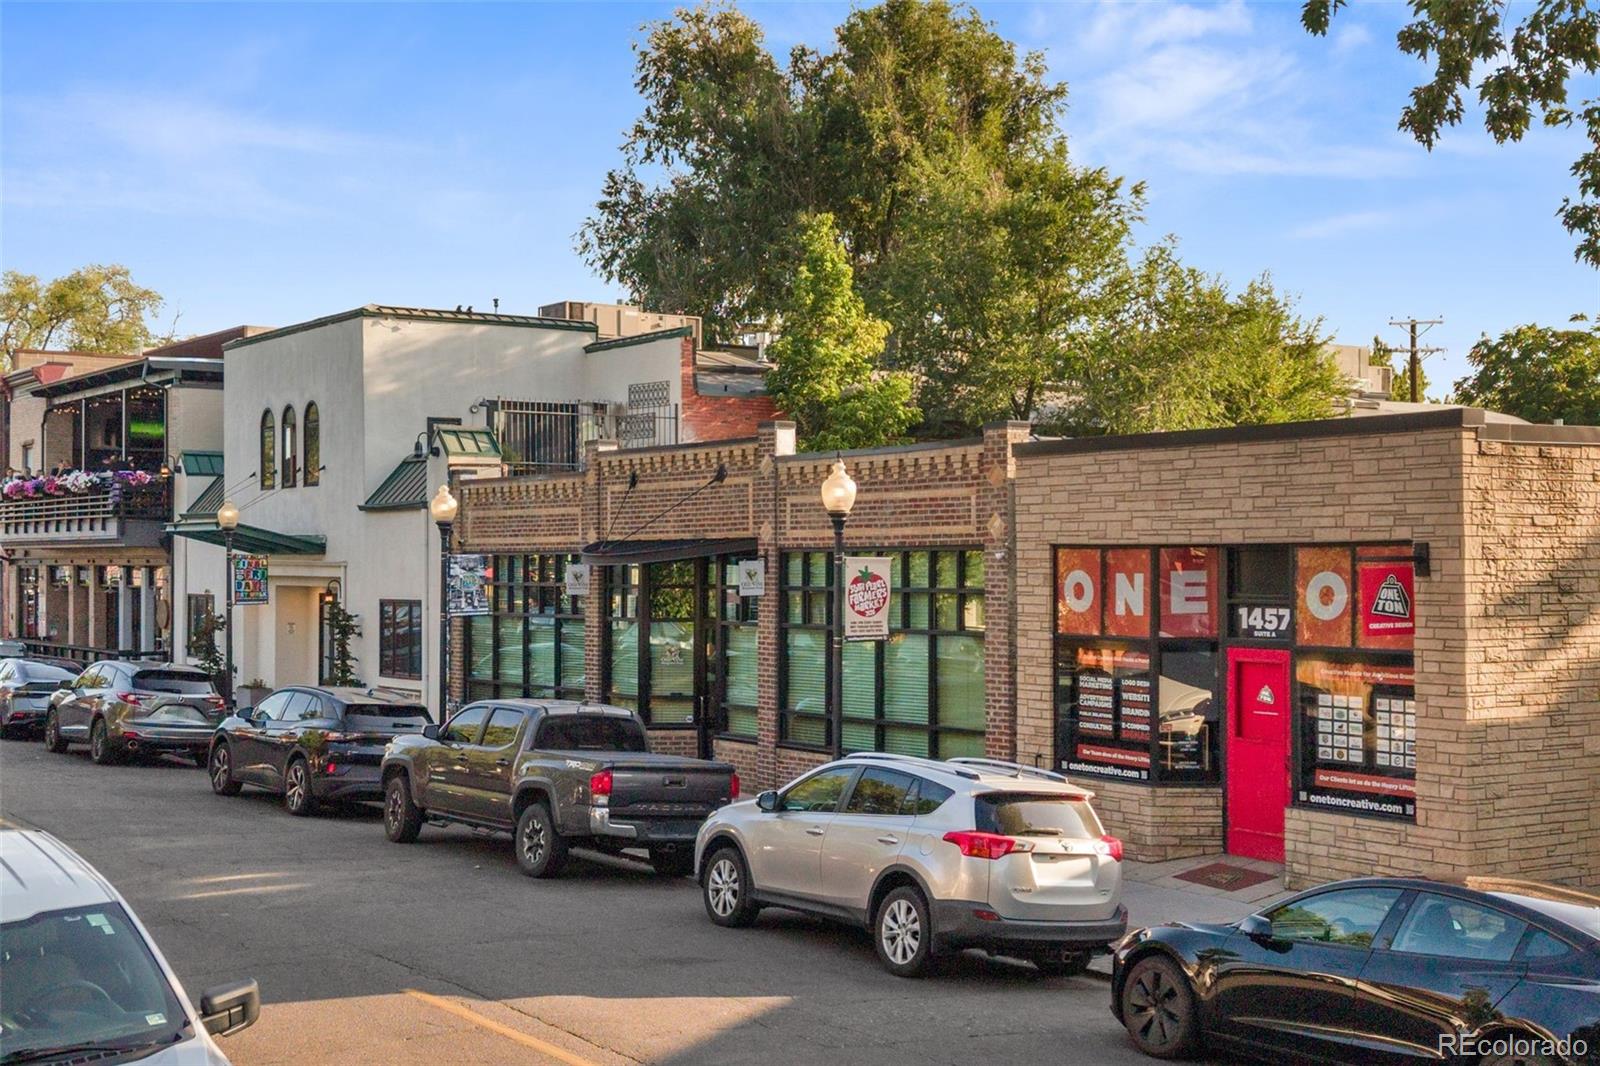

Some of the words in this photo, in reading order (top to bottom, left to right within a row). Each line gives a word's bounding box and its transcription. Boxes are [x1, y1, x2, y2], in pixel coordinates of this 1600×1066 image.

[1380, 588, 1401, 600] ONE
[1377, 600, 1404, 614] TON
[1238, 607, 1291, 631] 1457
[1079, 681, 1112, 690] MARKETING
[1079, 721, 1113, 731] CONSULTING
[1069, 762, 1140, 778] onetoncreative.com
[1330, 776, 1349, 784] Clients
[1380, 782, 1398, 791] Heavy
[1309, 794, 1403, 814] onetoncreative.com
